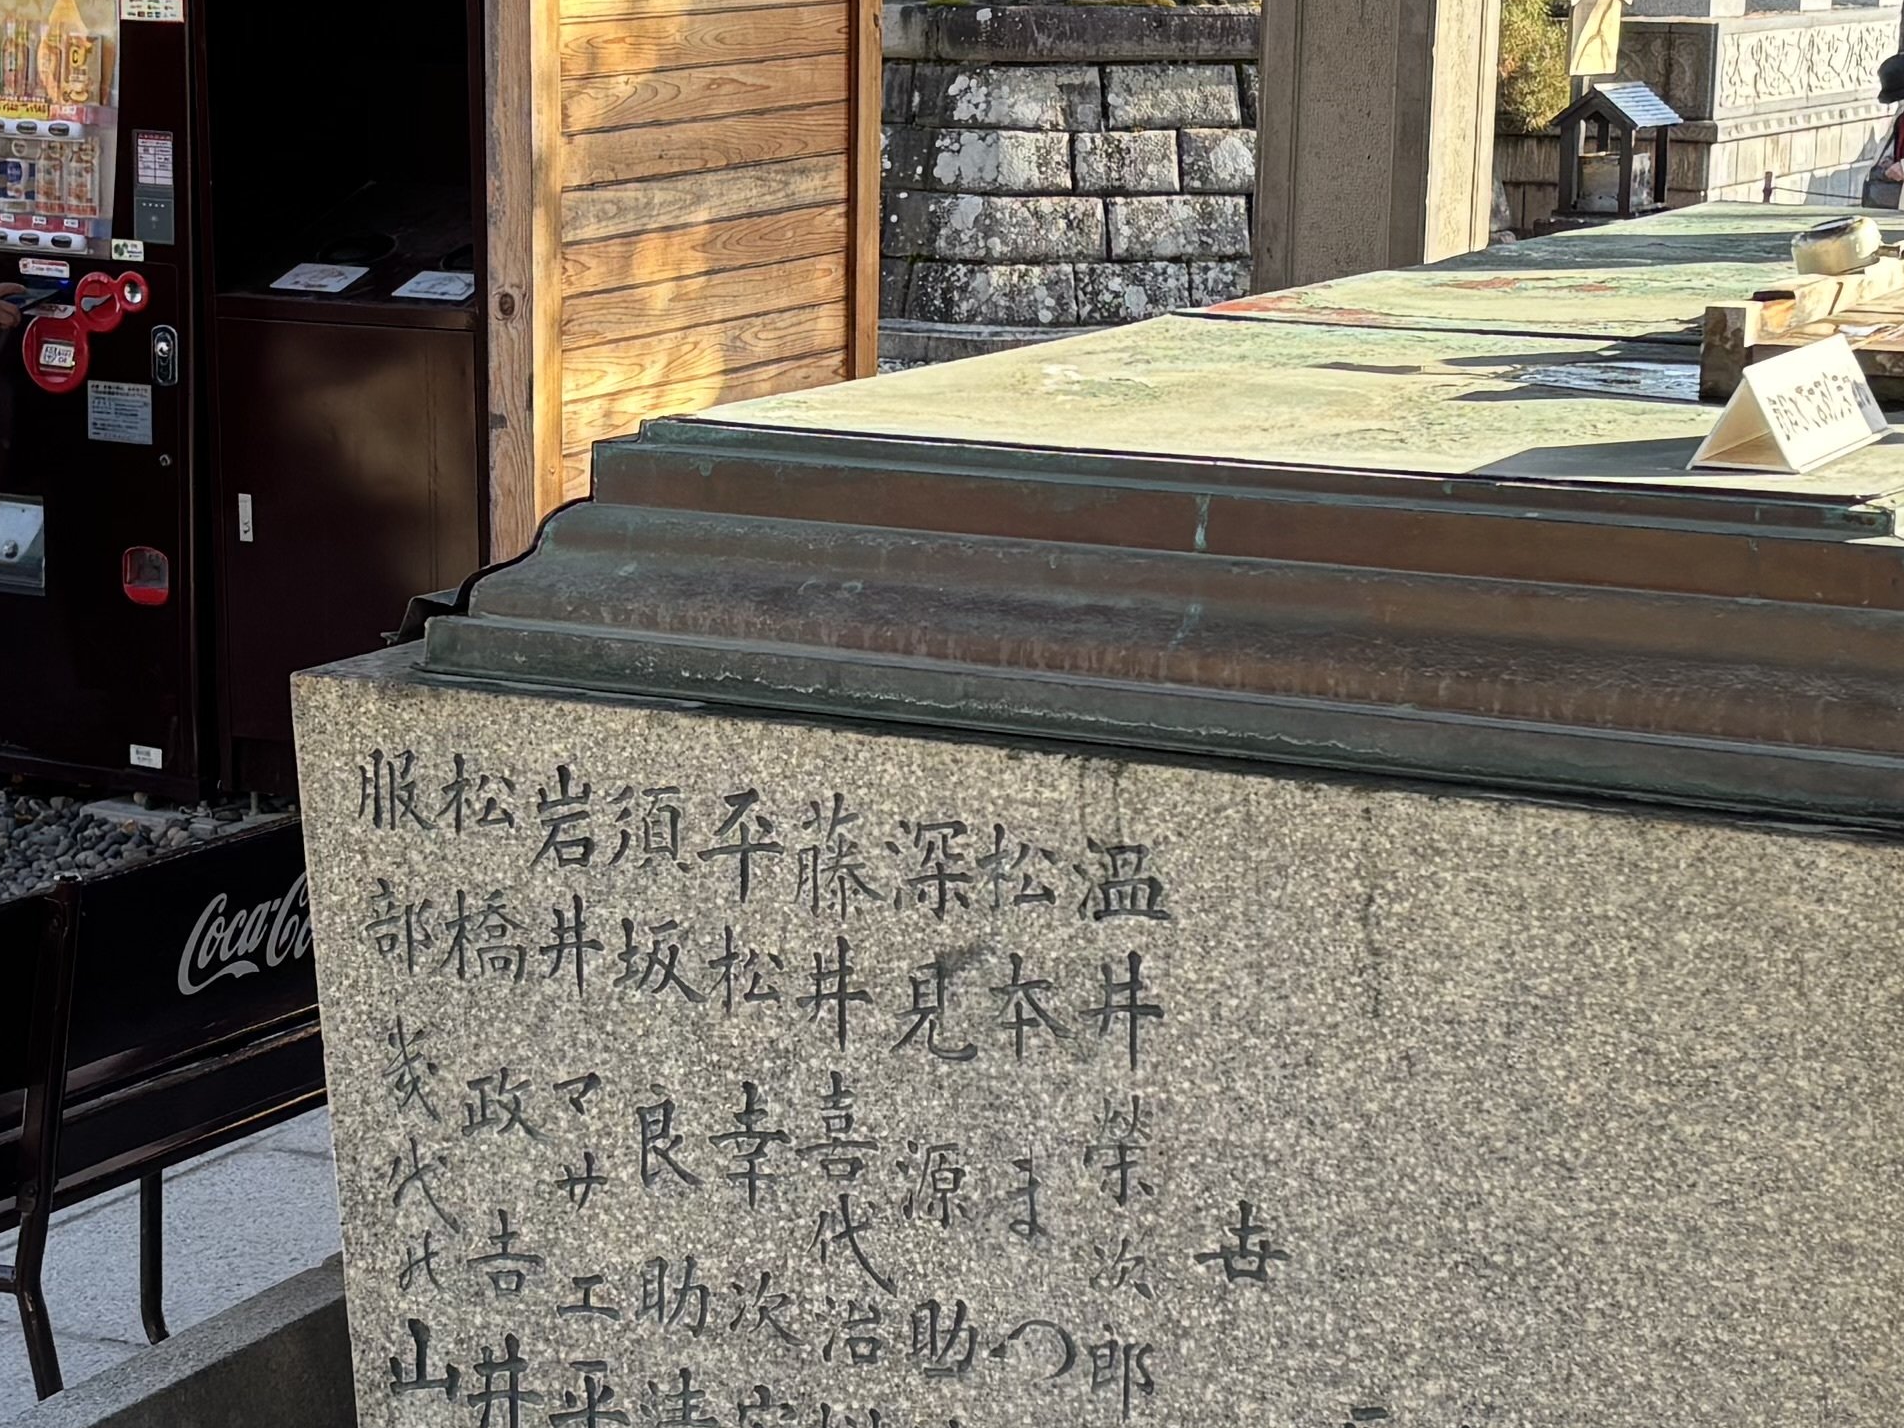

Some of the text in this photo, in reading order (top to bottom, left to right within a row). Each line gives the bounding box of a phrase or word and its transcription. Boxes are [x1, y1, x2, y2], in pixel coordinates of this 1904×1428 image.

[440, 752, 548, 1296] 松橋政吉
[608, 785, 708, 1338] 須坂良助
[698, 789, 803, 1347] 平松幸次
[796, 792, 894, 1364] 藤井喜代治
